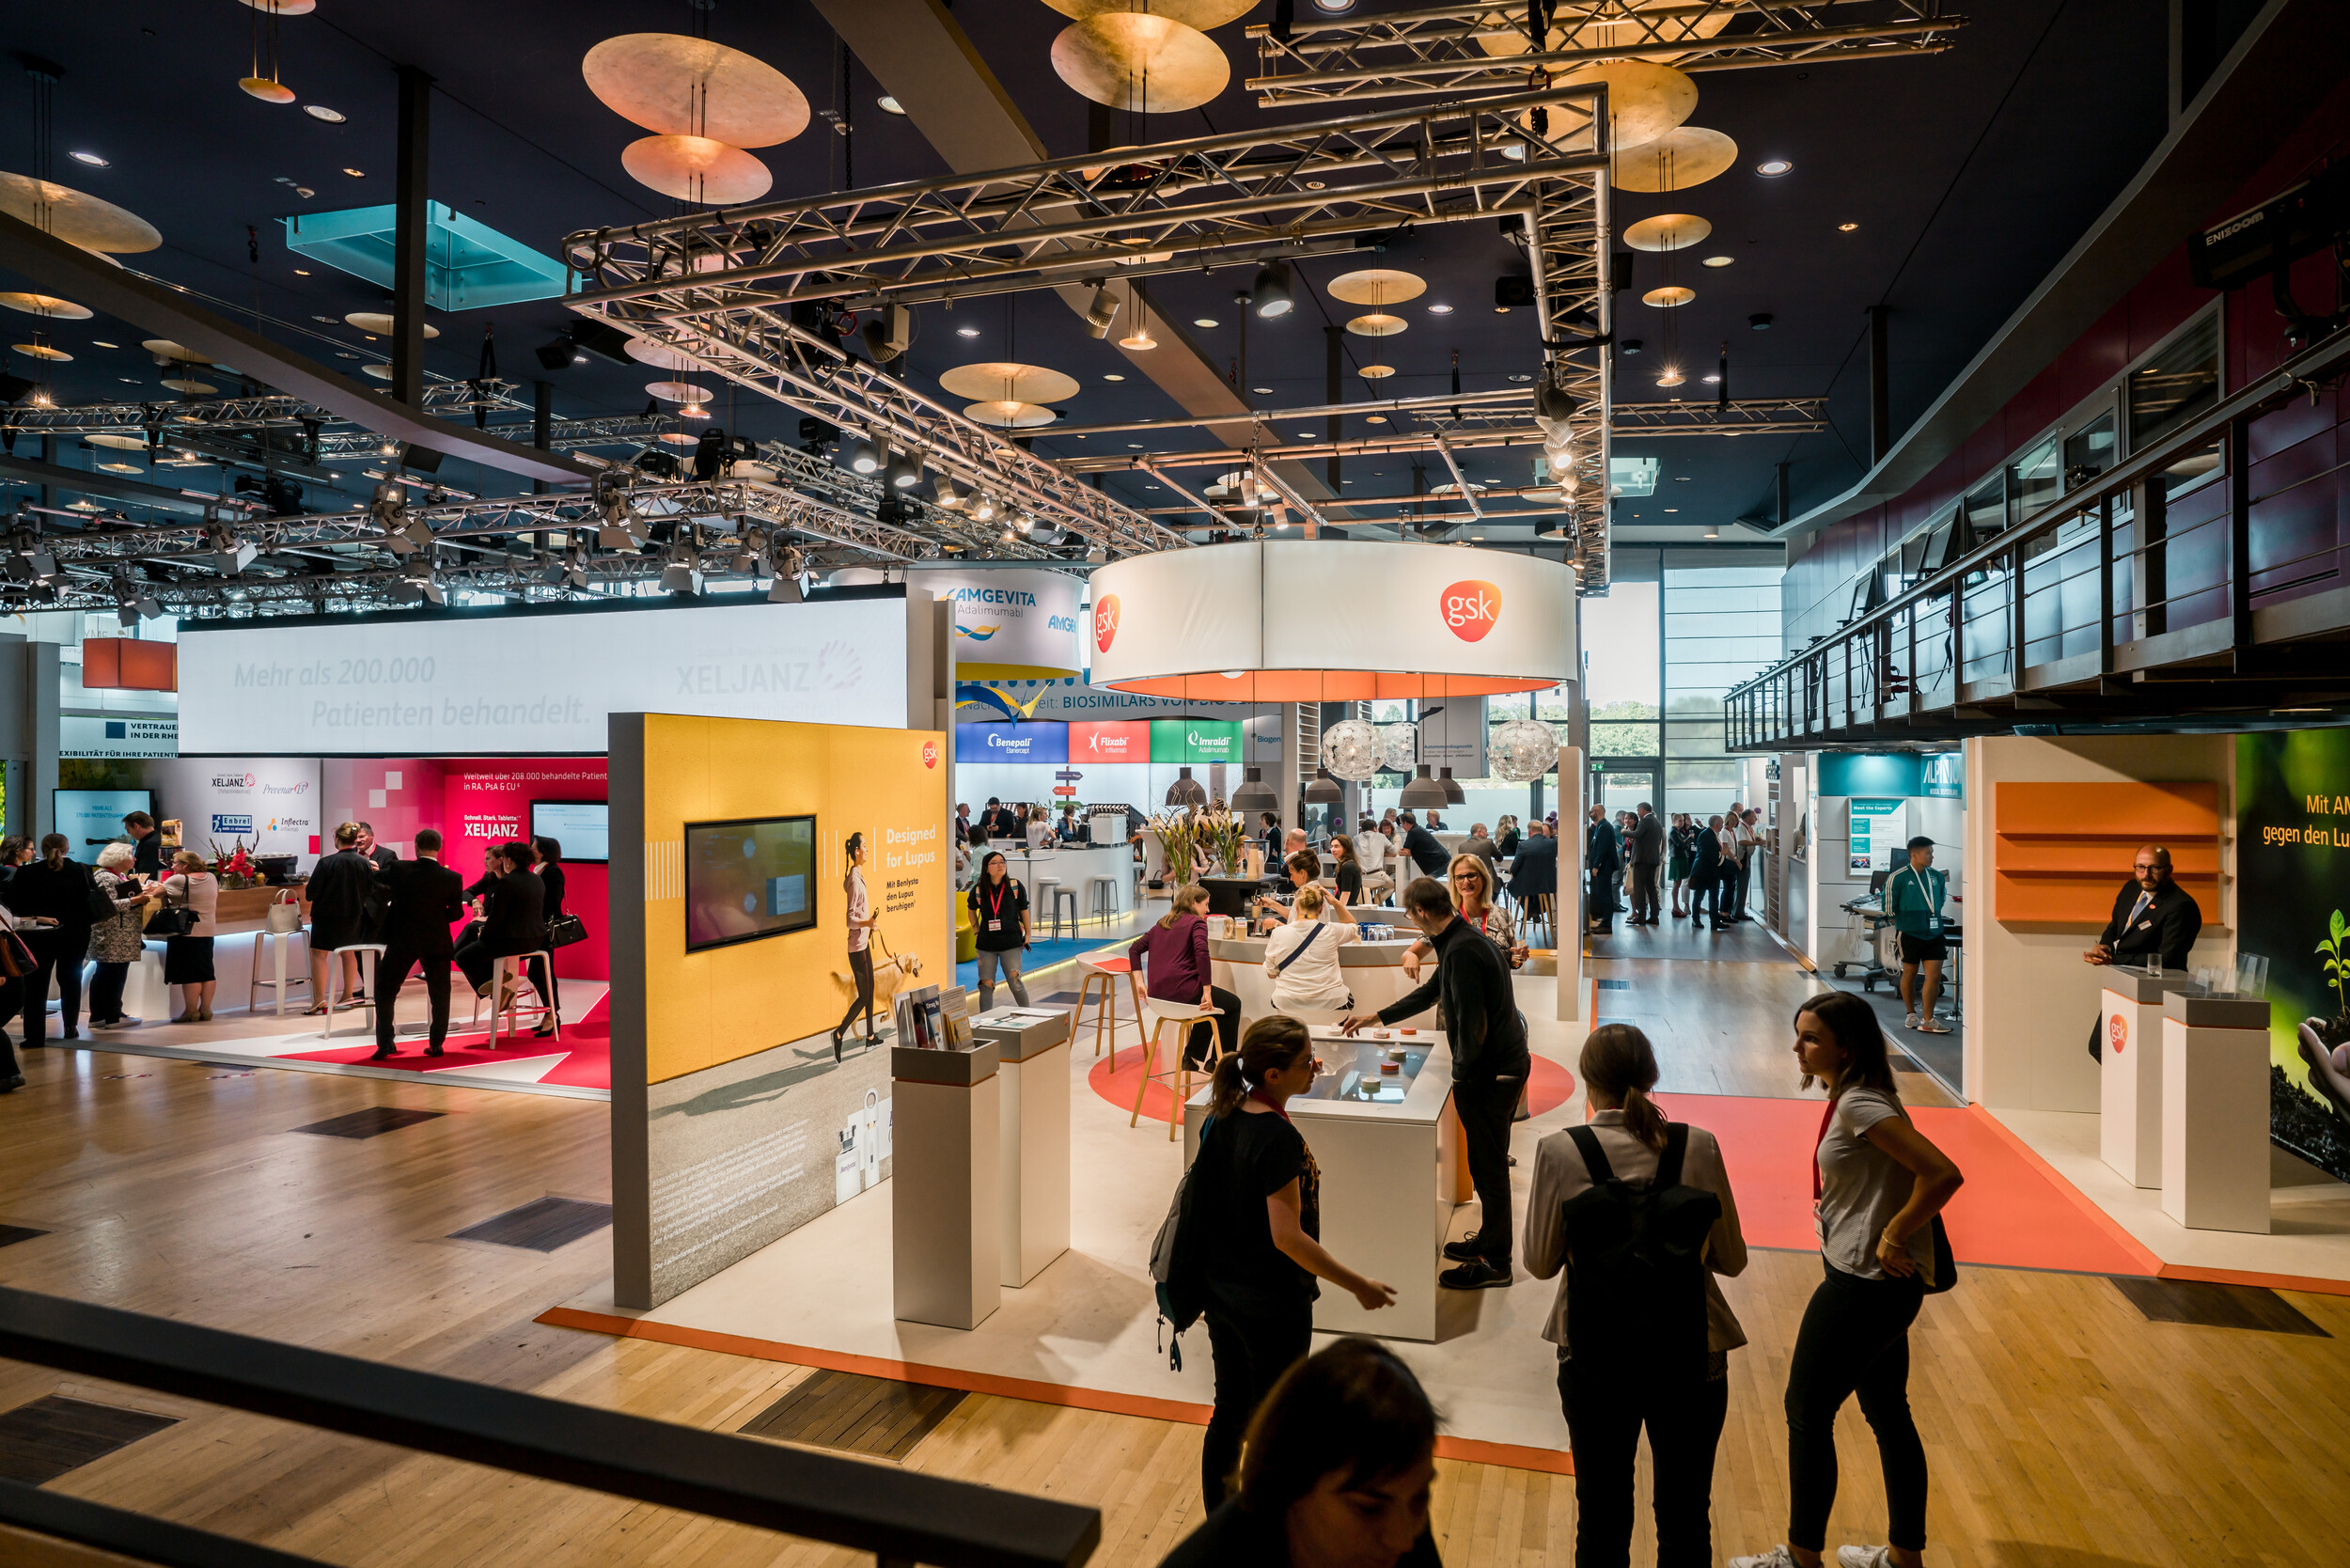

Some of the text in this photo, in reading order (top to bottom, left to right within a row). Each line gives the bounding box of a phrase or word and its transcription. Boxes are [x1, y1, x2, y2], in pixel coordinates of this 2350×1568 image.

[955, 588, 1036, 606] AMGEVITA
[1448, 590, 1495, 627] gsk
[1096, 604, 1117, 640] gsk
[234, 655, 436, 687] Mehr als 200.000
[676, 662, 810, 695] XELJANZ
[311, 695, 590, 727] Patienten behandelt.
[1063, 696, 1155, 708] BIOSIMILARS
[996, 738, 1030, 748] Benepali
[1101, 737, 1127, 746] Flixabi
[1198, 737, 1229, 745] Imraldi
[923, 745, 938, 764] gsk
[212, 778, 244, 787] XELJANZ
[495, 772, 510, 780] über
[541, 772, 580, 780] behandelte
[263, 784, 294, 794] Prevenar
[2306, 794, 2329, 814] Mit
[464, 823, 519, 840] XELJANZ
[886, 823, 936, 846] Designed
[2263, 825, 2300, 847] gegen
[2304, 824, 2329, 846] den
[886, 851, 935, 869] for Lupus
[886, 878, 919, 889] Mit Benlysta
[886, 890, 914, 901] den Lupus
[2110, 1022, 2126, 1043] gsk
